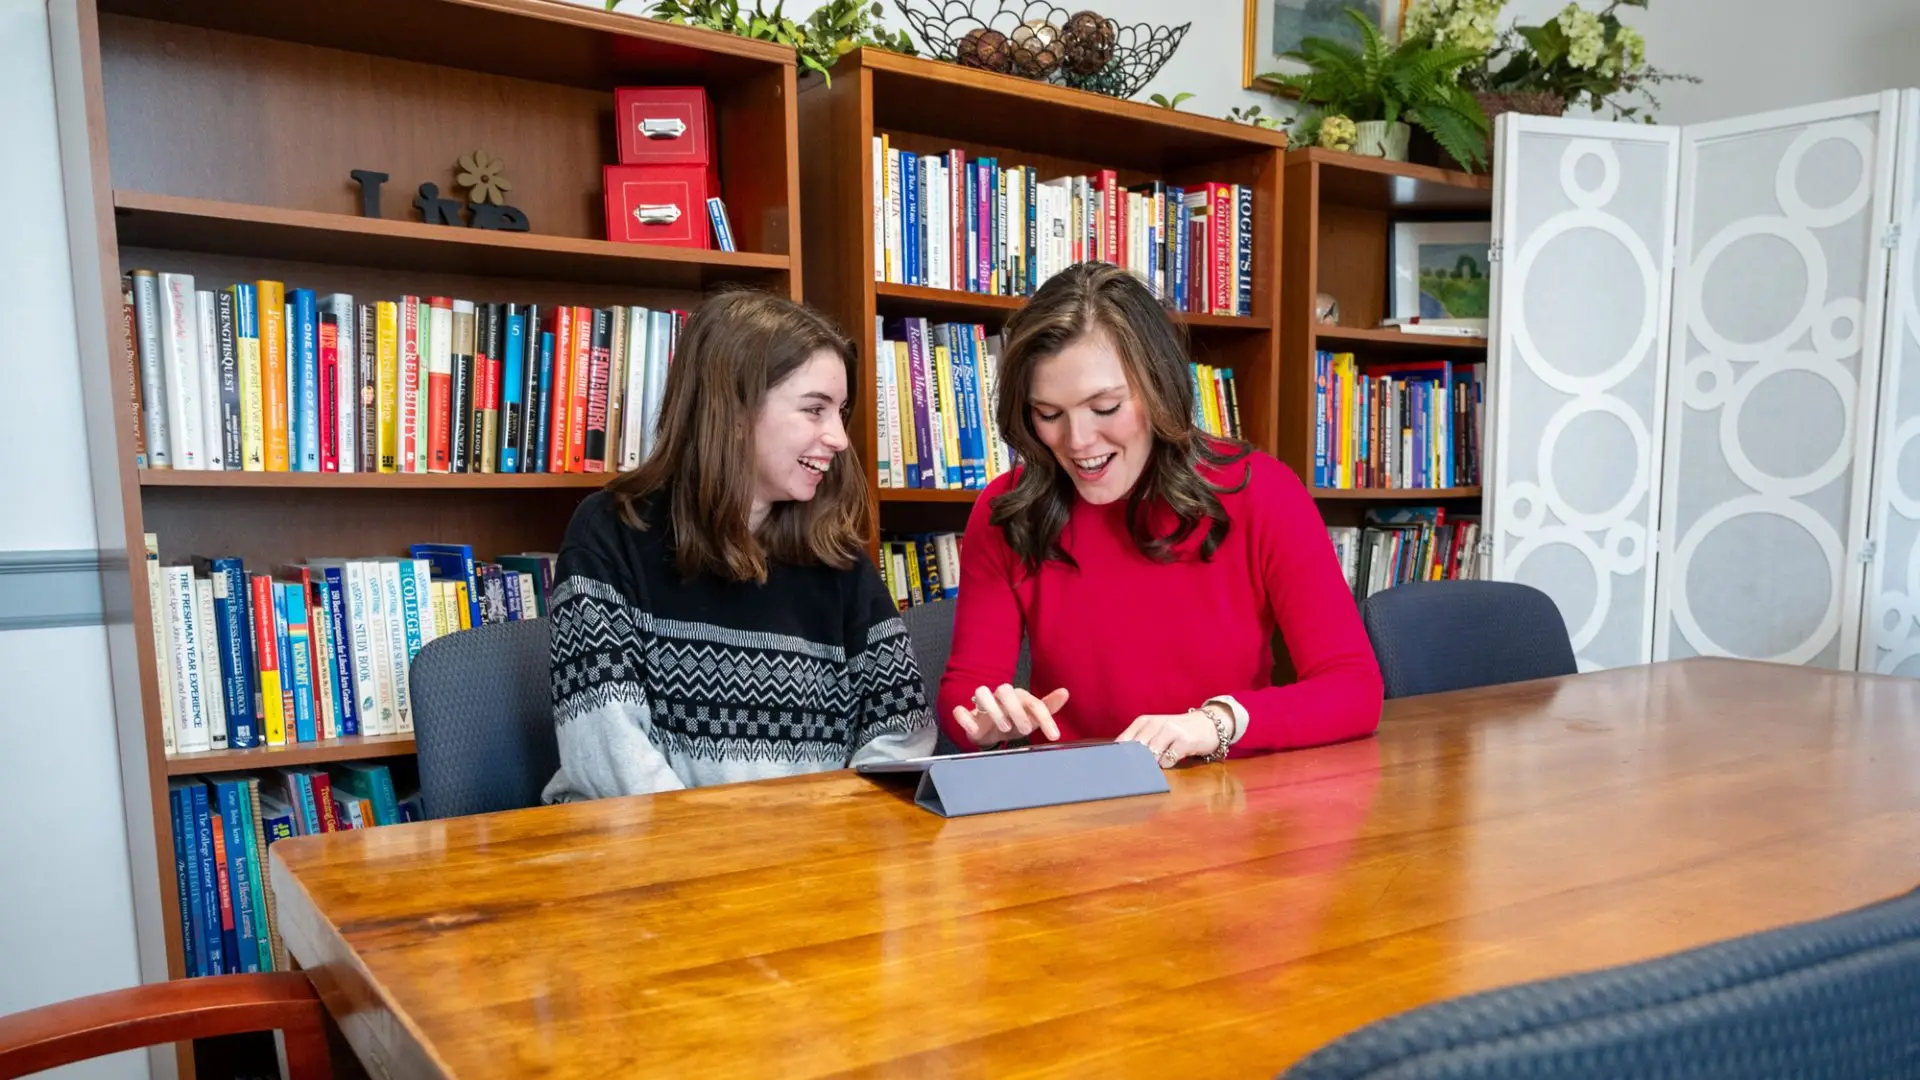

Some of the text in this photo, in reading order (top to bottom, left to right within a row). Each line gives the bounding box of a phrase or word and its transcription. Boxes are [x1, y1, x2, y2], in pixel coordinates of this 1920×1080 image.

[1240, 187, 1252, 272] ROGET'S
[1217, 198, 1226, 307] COLLEGE DICTIONARY
[219, 293, 234, 392] STRENGTHSQUEST
[250, 362, 260, 389] what
[590, 352, 609, 383] END
[950, 326, 967, 428] Gallery of Best Resumes
[962, 327, 978, 429] Gallery of Best Resumes
[304, 322, 315, 449] ONE PIECE OF PAPER
[404, 340, 417, 441] CREDIBILITY
[912, 371, 926, 408] Magic
[588, 390, 607, 432] WORK
[876, 376, 886, 439] RESUMES
[892, 435, 902, 466] BOOK
[924, 542, 940, 596] CLICK
[226, 568, 238, 605] COMPLETE
[322, 588, 330, 612] YOUR
[200, 588, 213, 626] FAREED
[228, 606, 240, 638] BUSINESS
[333, 600, 341, 612] Best
[403, 578, 420, 637] COLLEGE
[478, 596, 486, 616] First
[324, 614, 332, 639] FIRST
[334, 613, 344, 644] Companies
[355, 624, 368, 652] STUDY
[180, 572, 202, 729] THE FRESHMAN YEAR EXPERIENCE
[204, 628, 217, 673] ZAKARIA
[231, 638, 242, 676] ETIQUETTE
[294, 642, 308, 686] WISHCRAFT
[337, 645, 345, 653] for
[338, 654, 348, 675] Liberal
[377, 645, 388, 680] COLLEGE
[390, 620, 401, 651] COLLEGE
[397, 688, 407, 707] BOOK
[341, 676, 350, 688] Arts
[360, 656, 370, 682] BOOK
[234, 676, 246, 716] HANDBOOK
[342, 688, 352, 718] Graduates
[380, 681, 390, 704] BOOK
[199, 812, 208, 826] The
[321, 786, 334, 820] Training
[200, 828, 211, 857] College
[204, 858, 213, 888] Learner
[235, 856, 246, 874] Keys
[239, 882, 250, 909] Effective
[242, 910, 254, 940] Learning
